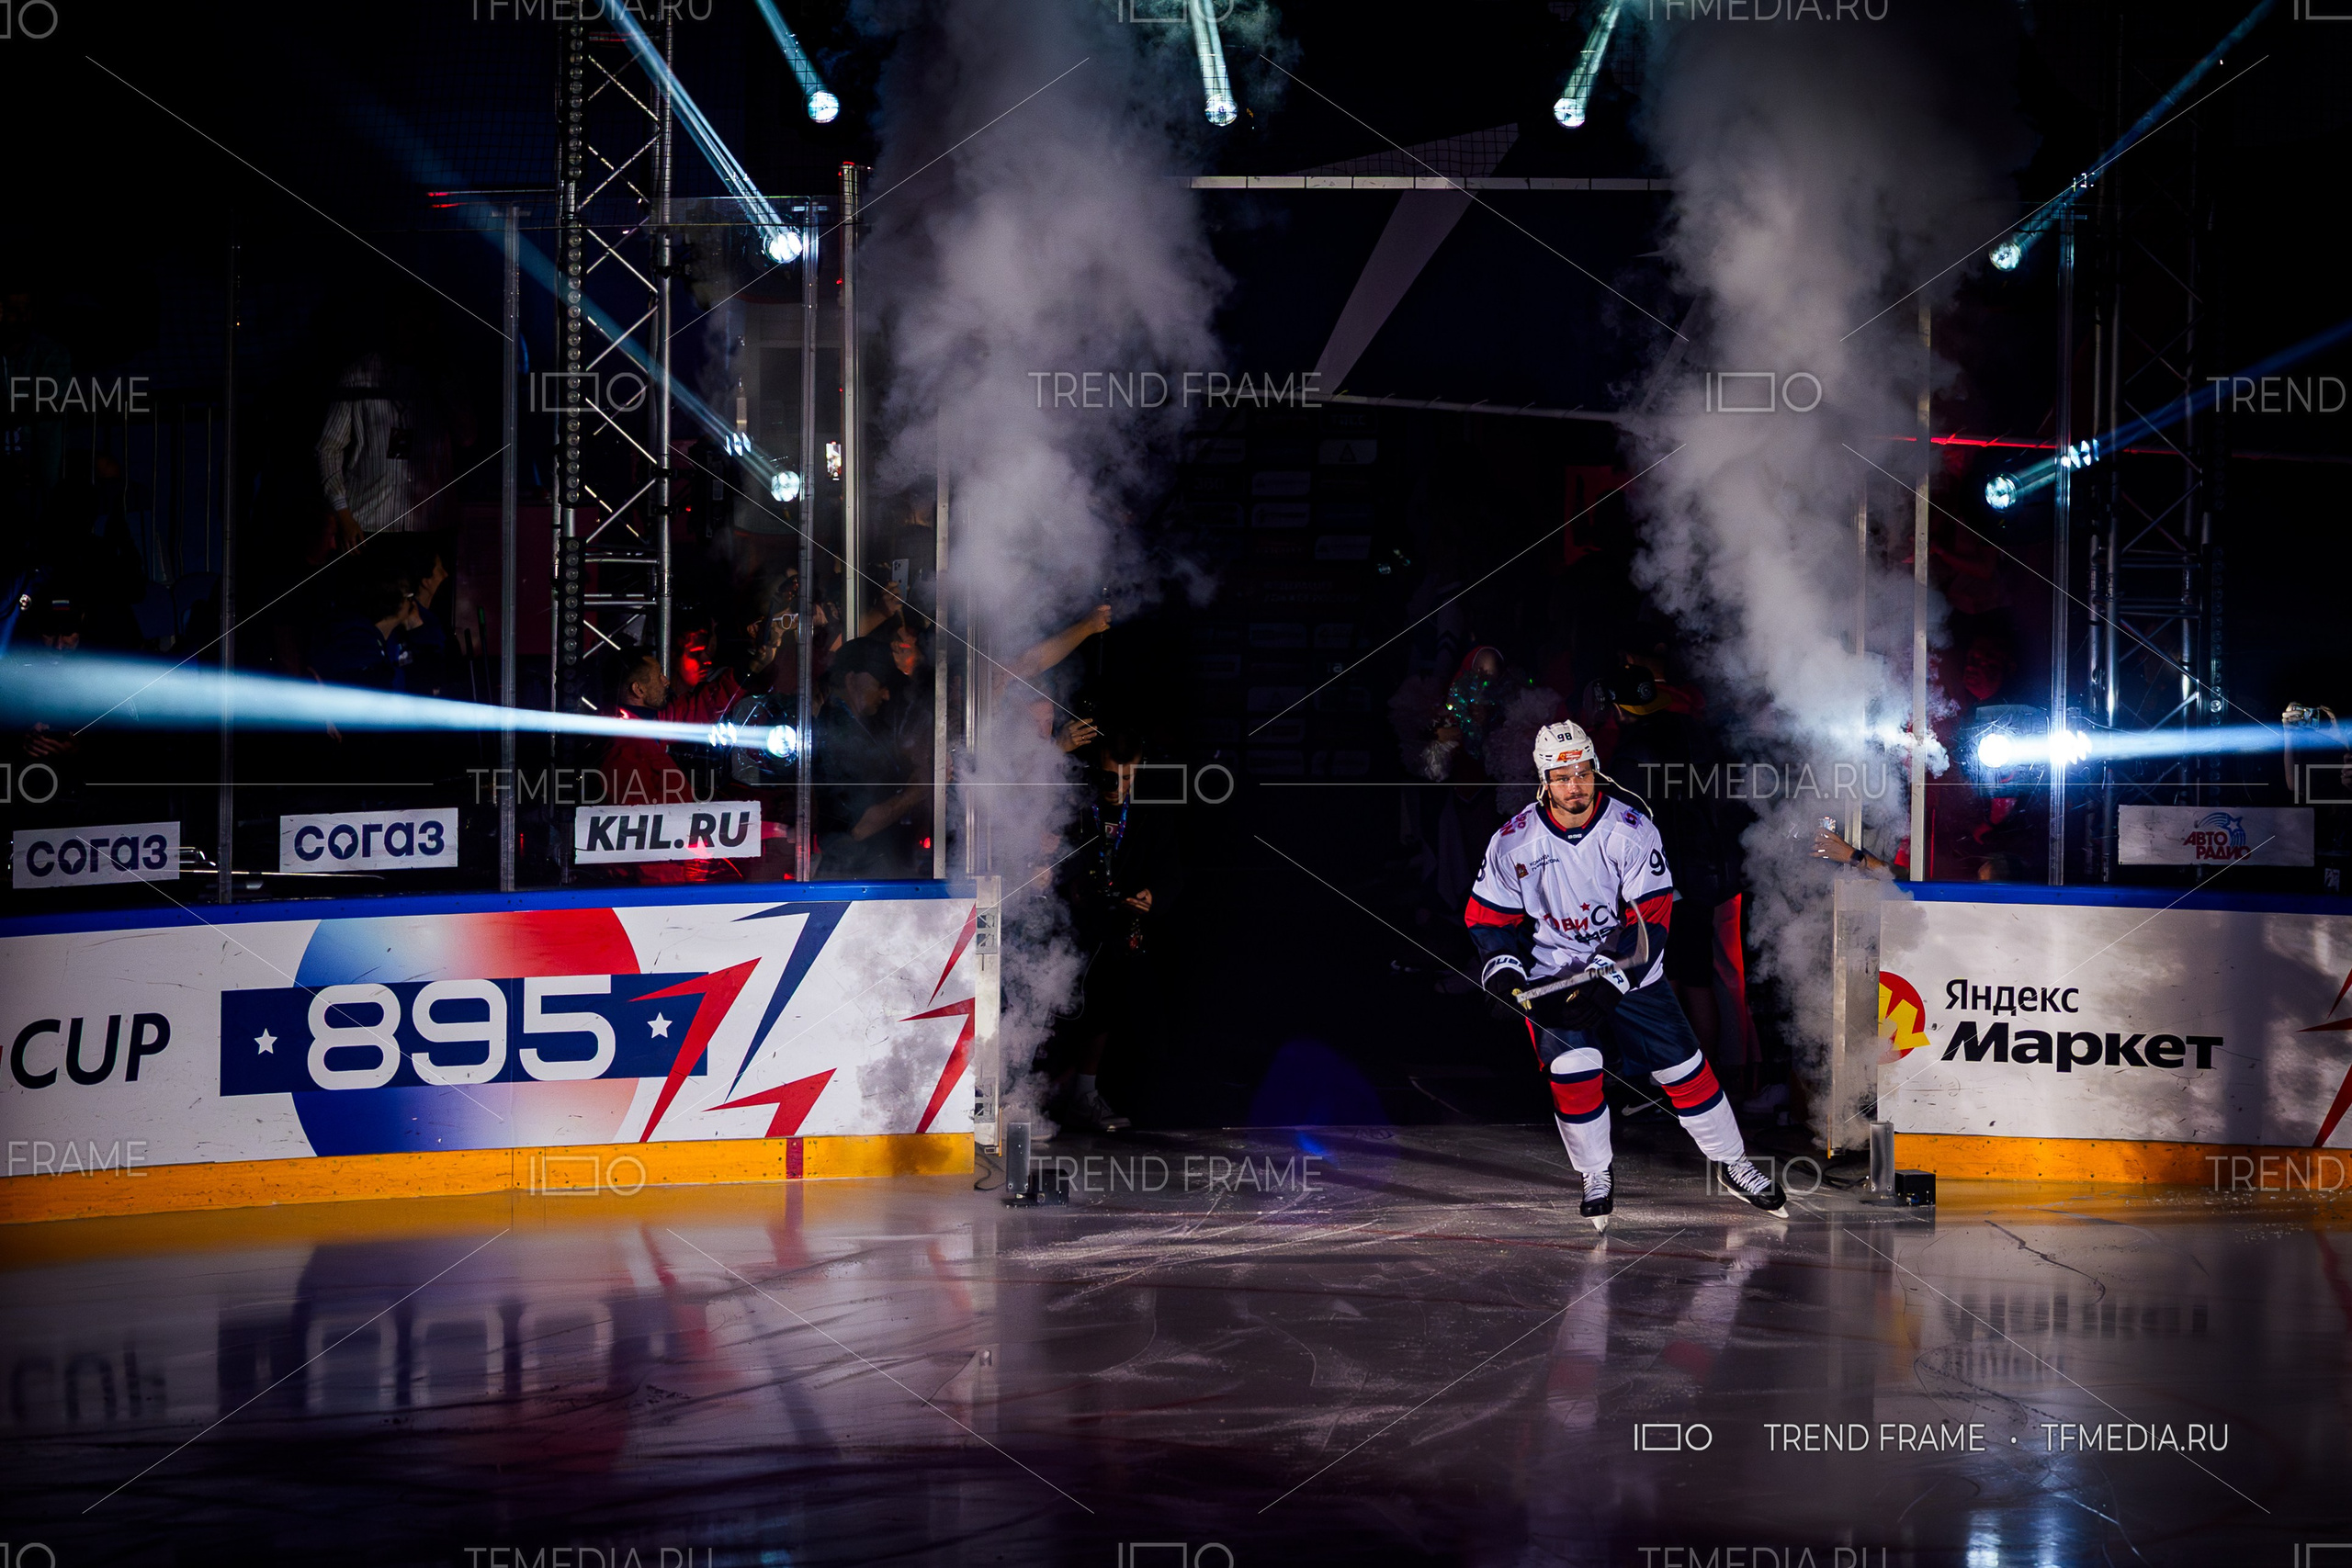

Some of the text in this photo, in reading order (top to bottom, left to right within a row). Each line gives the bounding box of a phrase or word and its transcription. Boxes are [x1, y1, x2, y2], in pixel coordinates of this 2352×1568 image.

[1556, 732, 1573, 742] 98
[586, 811, 751, 851] KHL.RU
[2183, 831, 2228, 846] АВТО
[1650, 848, 1669, 876] 9
[2196, 845, 2252, 860] РАДИО
[1945, 978, 2079, 1016] Яндекс
[0, 1012, 172, 1089] CUP
[307, 975, 616, 1090] 895
[1940, 1021, 2224, 1073] Маркет
